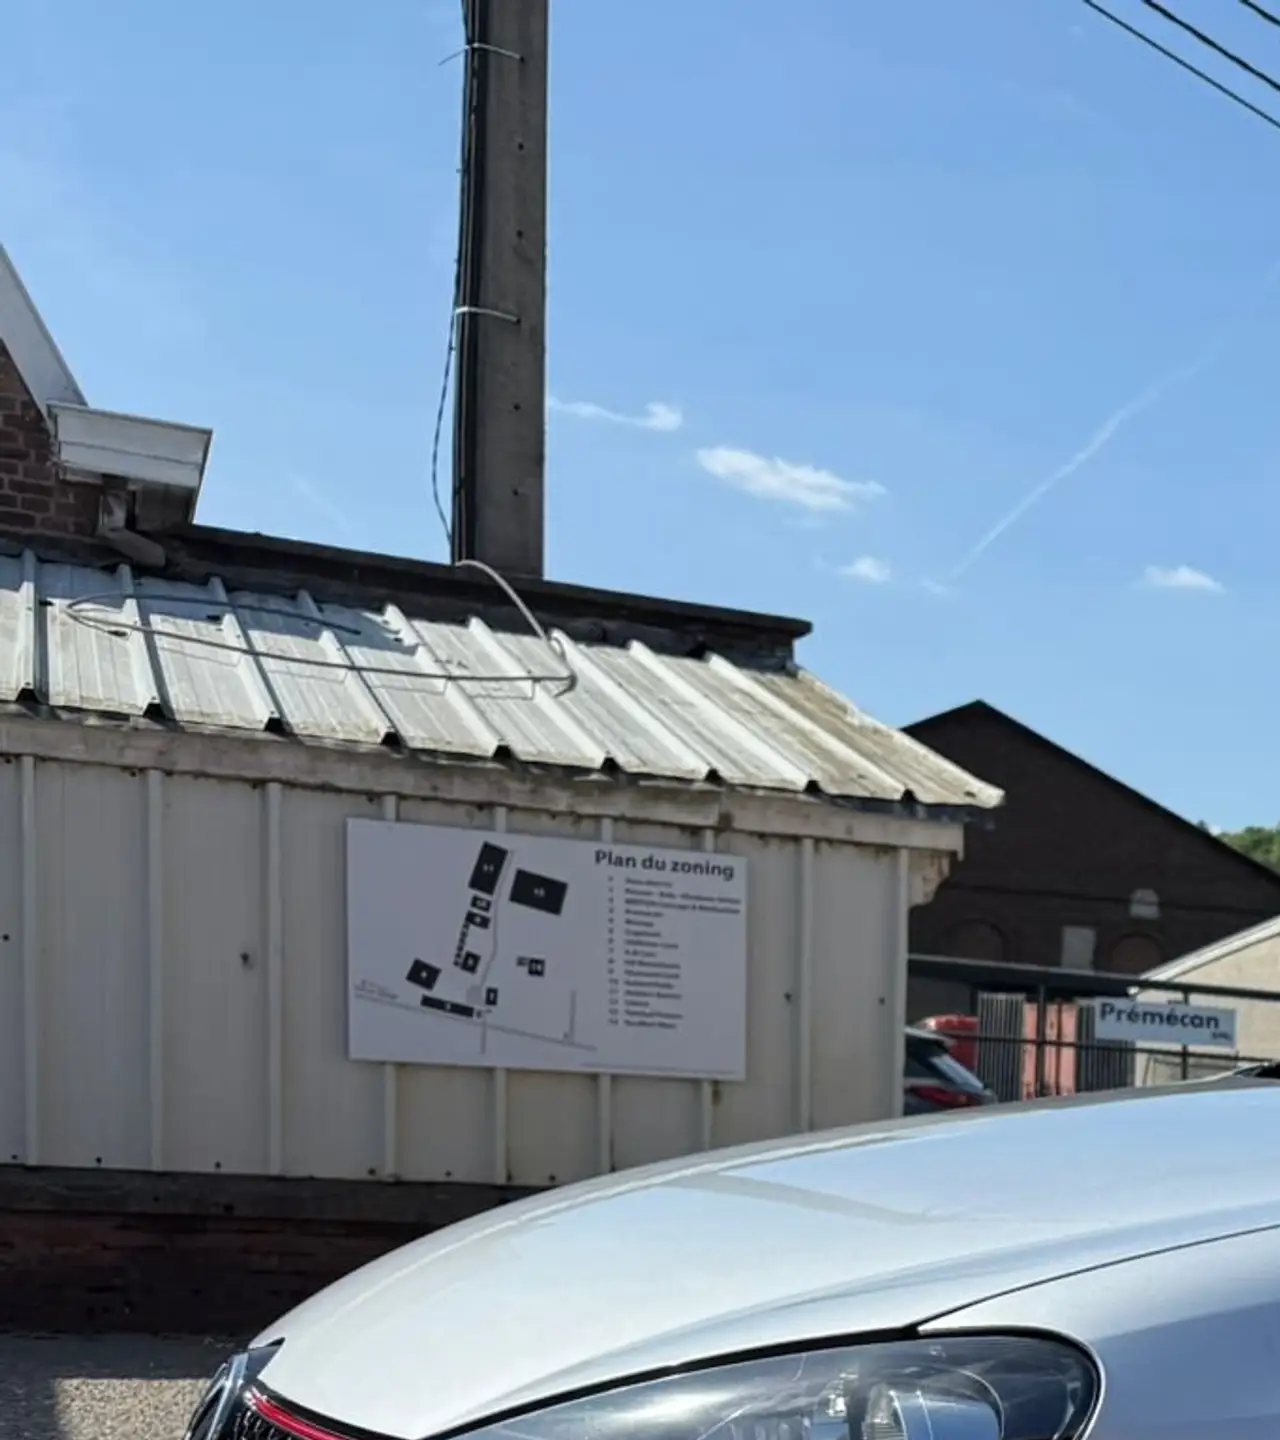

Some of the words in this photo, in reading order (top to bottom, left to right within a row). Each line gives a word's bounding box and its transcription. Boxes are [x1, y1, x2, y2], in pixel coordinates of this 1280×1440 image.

[594, 849, 637, 869] Plan
[641, 854, 667, 872] du
[669, 860, 735, 881] zoning
